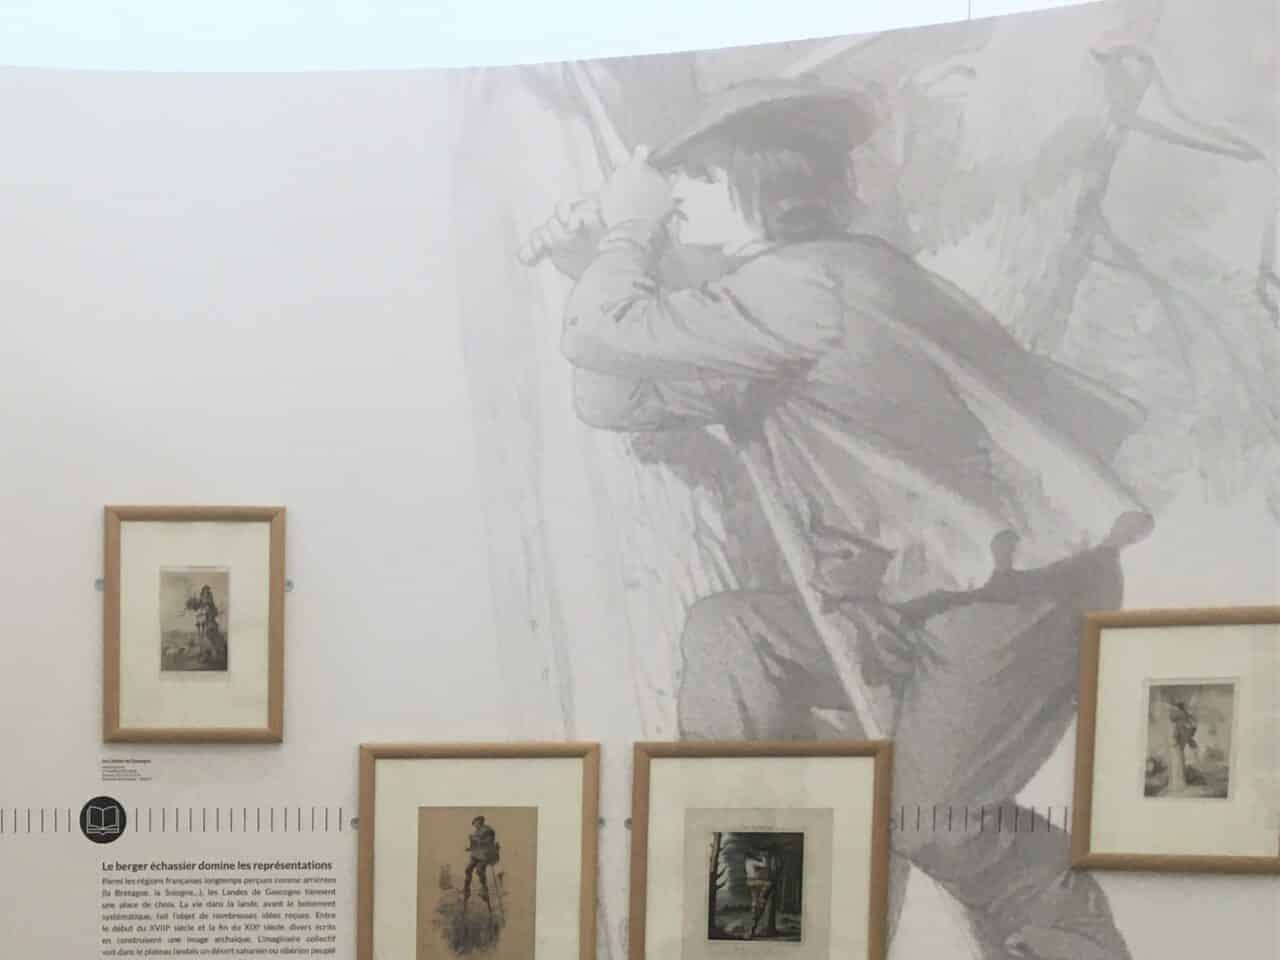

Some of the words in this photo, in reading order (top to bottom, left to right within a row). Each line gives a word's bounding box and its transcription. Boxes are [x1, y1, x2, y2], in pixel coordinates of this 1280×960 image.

[102, 862, 113, 871] Le
[115, 861, 148, 873] berger
[150, 861, 196, 871] échassier
[198, 861, 236, 871] domine
[237, 861, 252, 870] les
[253, 861, 333, 872] représentations
[265, 889, 301, 897] Gascogne
[119, 901, 138, 910] place
[112, 924, 134, 932] début
[288, 923, 311, 931] divers
[187, 936, 209, 945] image
[305, 935, 336, 943] collectif
